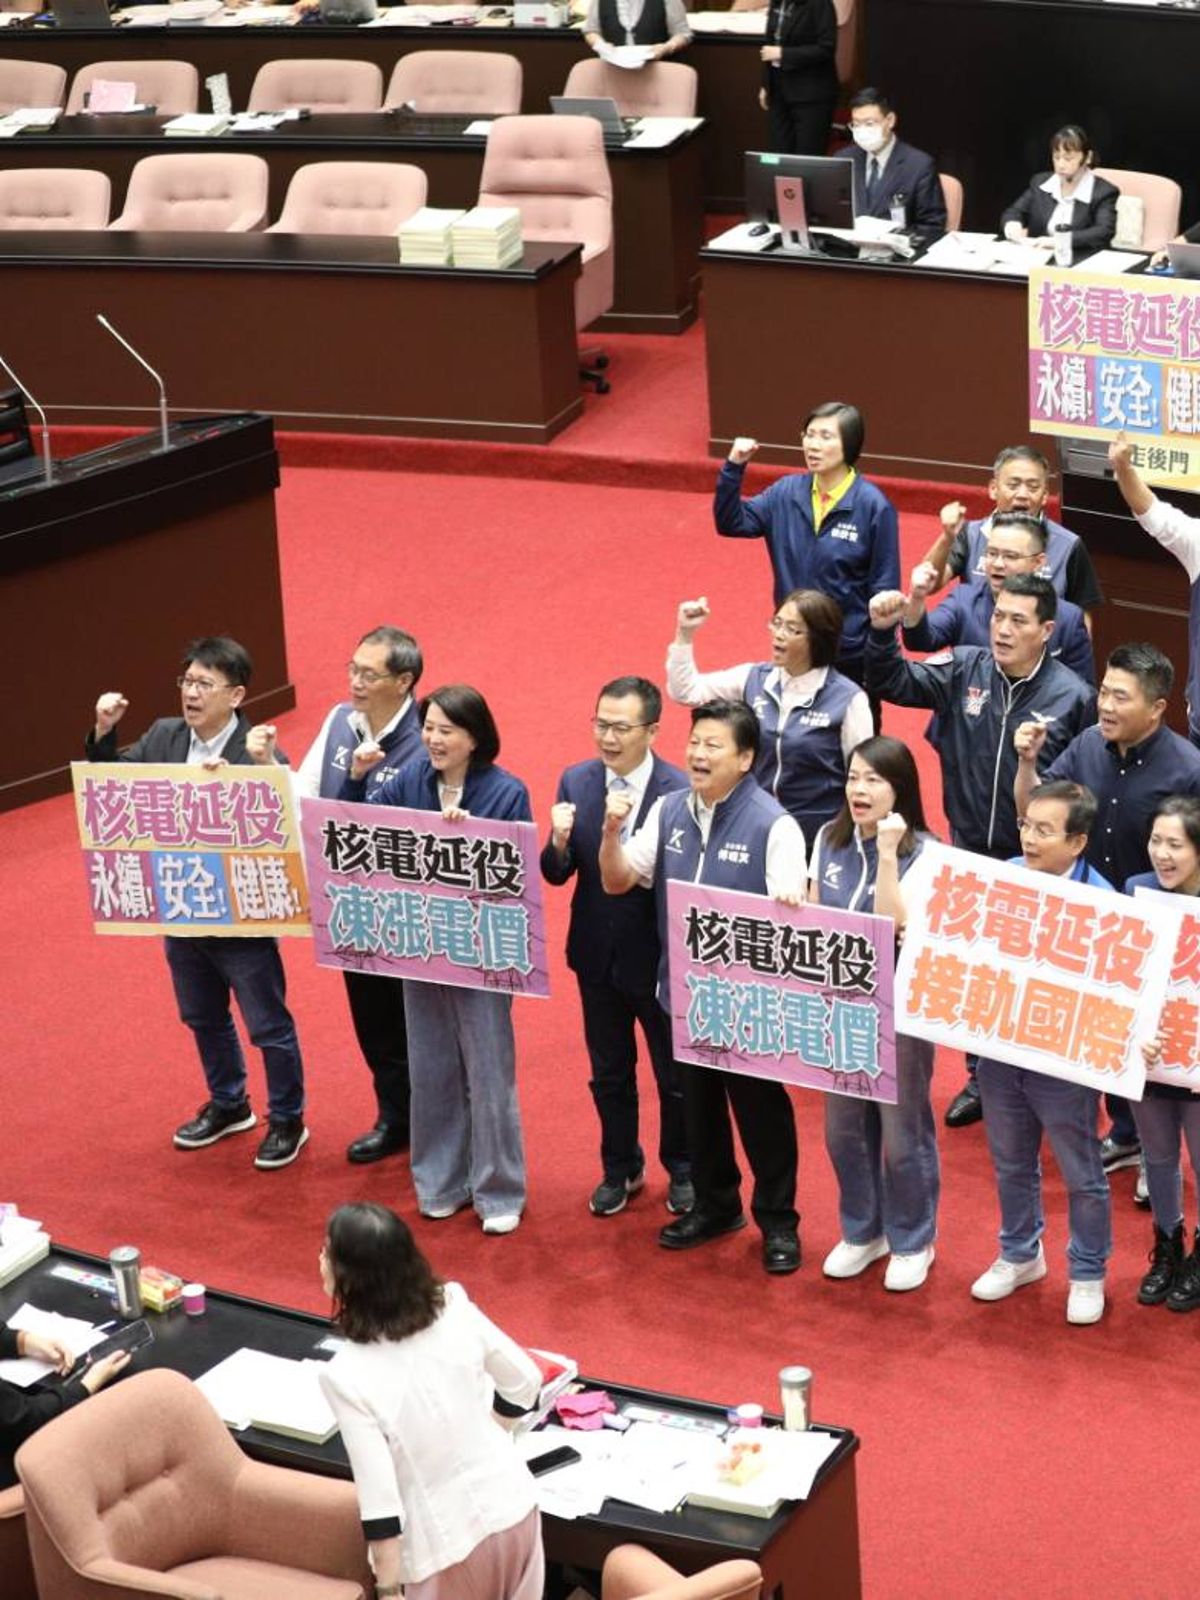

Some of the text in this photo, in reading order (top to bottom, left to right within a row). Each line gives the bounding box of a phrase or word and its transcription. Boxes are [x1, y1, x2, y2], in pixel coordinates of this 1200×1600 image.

[1100, 359, 1158, 428] 安全!
[81, 777, 286, 847] 核電延役
[159, 854, 226, 919] 安全!
[230, 855, 301, 920] 健康!
[322, 819, 525, 896] 核電延役
[325, 883, 533, 976] 凍漲電價
[684, 906, 877, 993] 核電延役
[925, 864, 1155, 991] 核電延役
[686, 971, 882, 1079] 凍漲電價
[906, 947, 1136, 1073] 接軌國際
